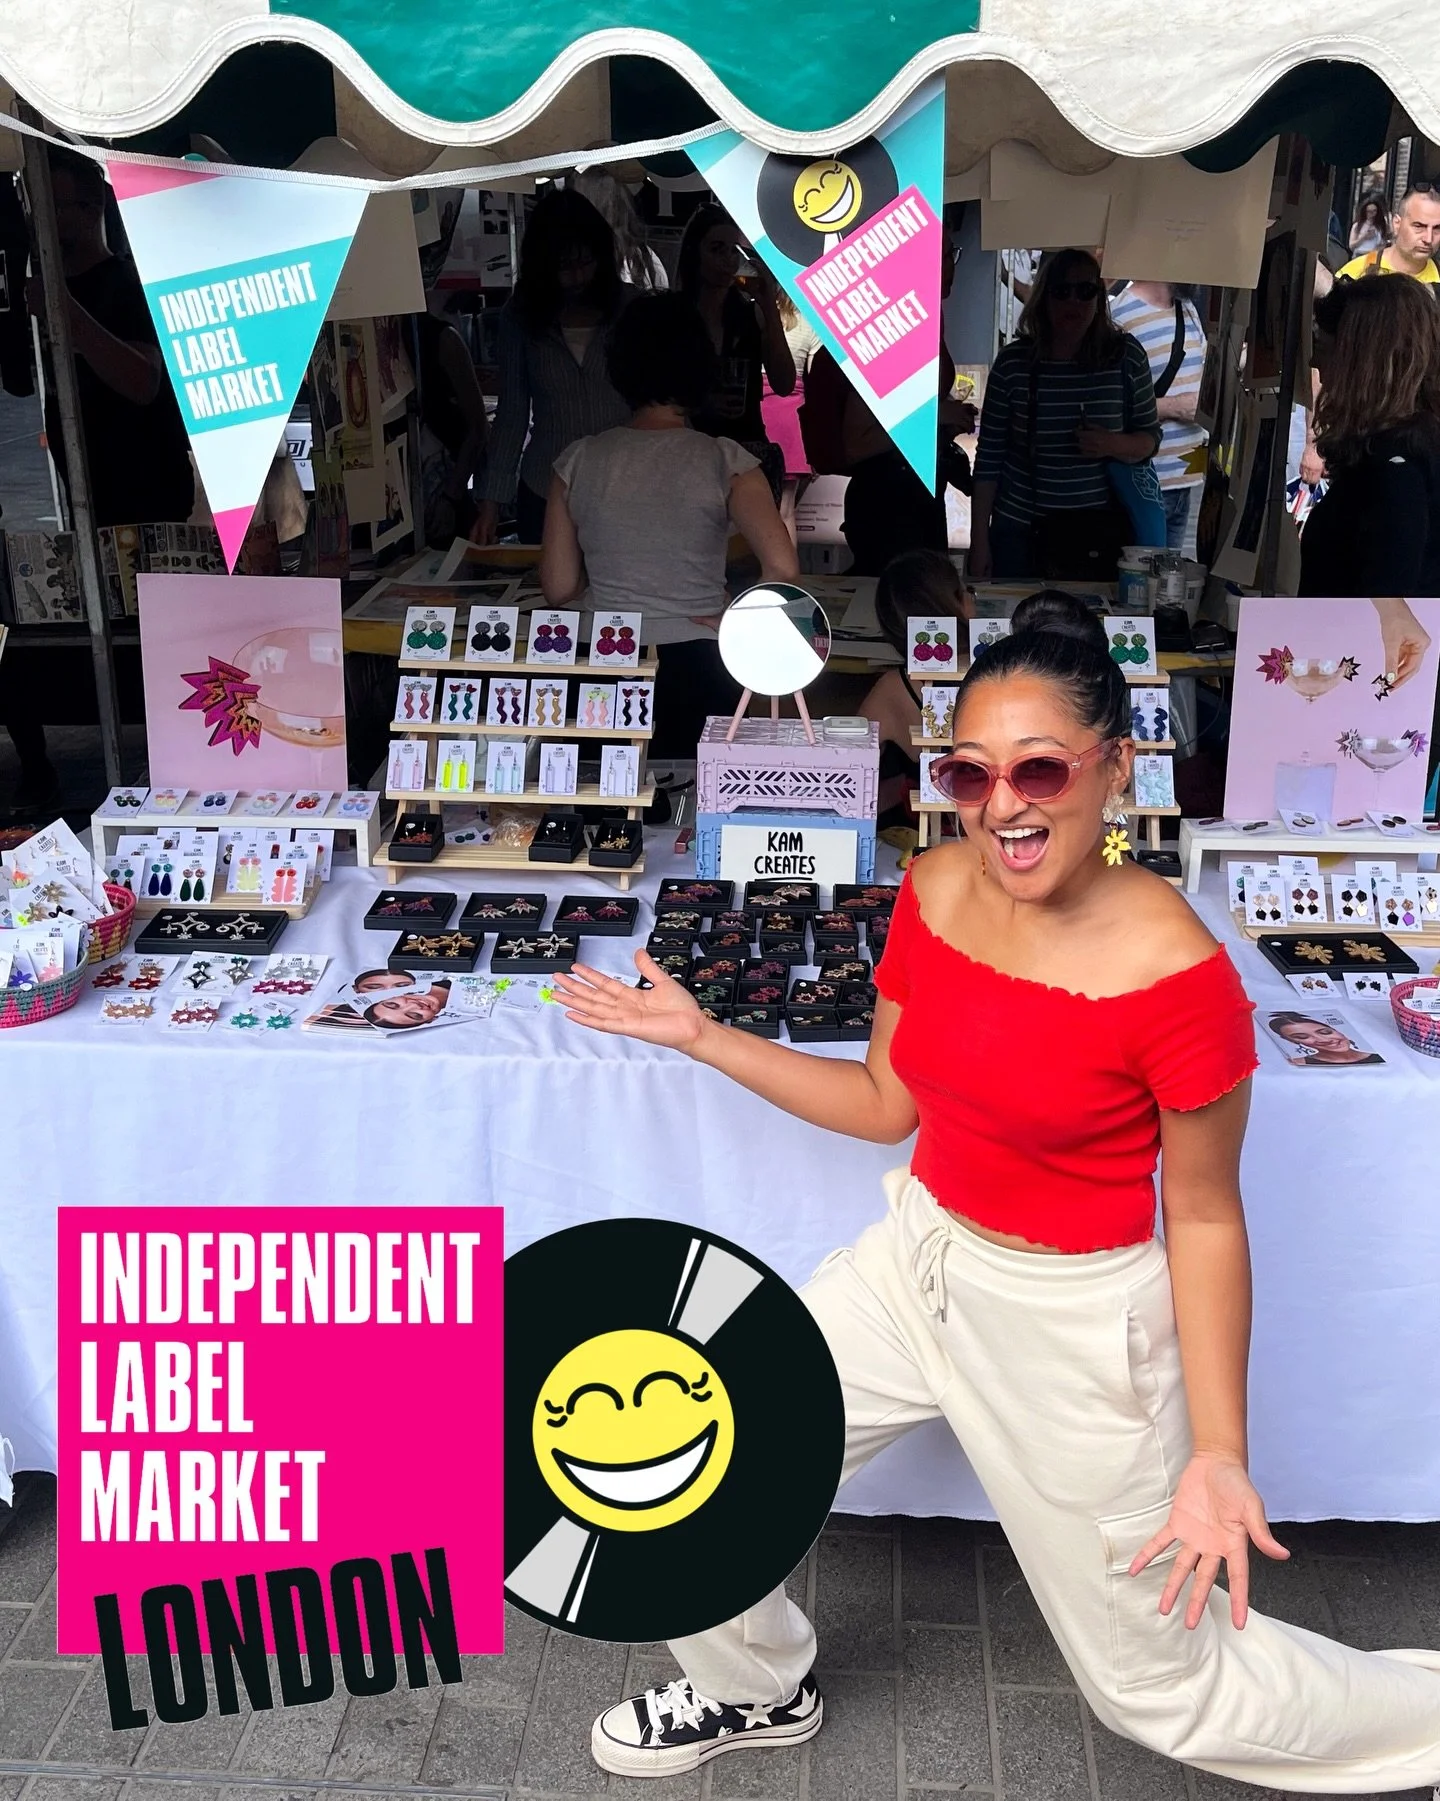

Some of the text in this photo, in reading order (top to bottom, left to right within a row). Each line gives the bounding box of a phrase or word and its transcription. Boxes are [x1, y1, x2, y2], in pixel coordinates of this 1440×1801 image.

[804, 195, 930, 306] INDEPENDENT
[159, 261, 317, 335] INDEPENDENT
[826, 276, 891, 337] LABEL
[848, 289, 930, 366] MARKET
[172, 326, 247, 378] LABEL
[185, 362, 284, 420] MARKET
[754, 855, 816, 875] CREATES
[767, 831, 803, 853] KAM
